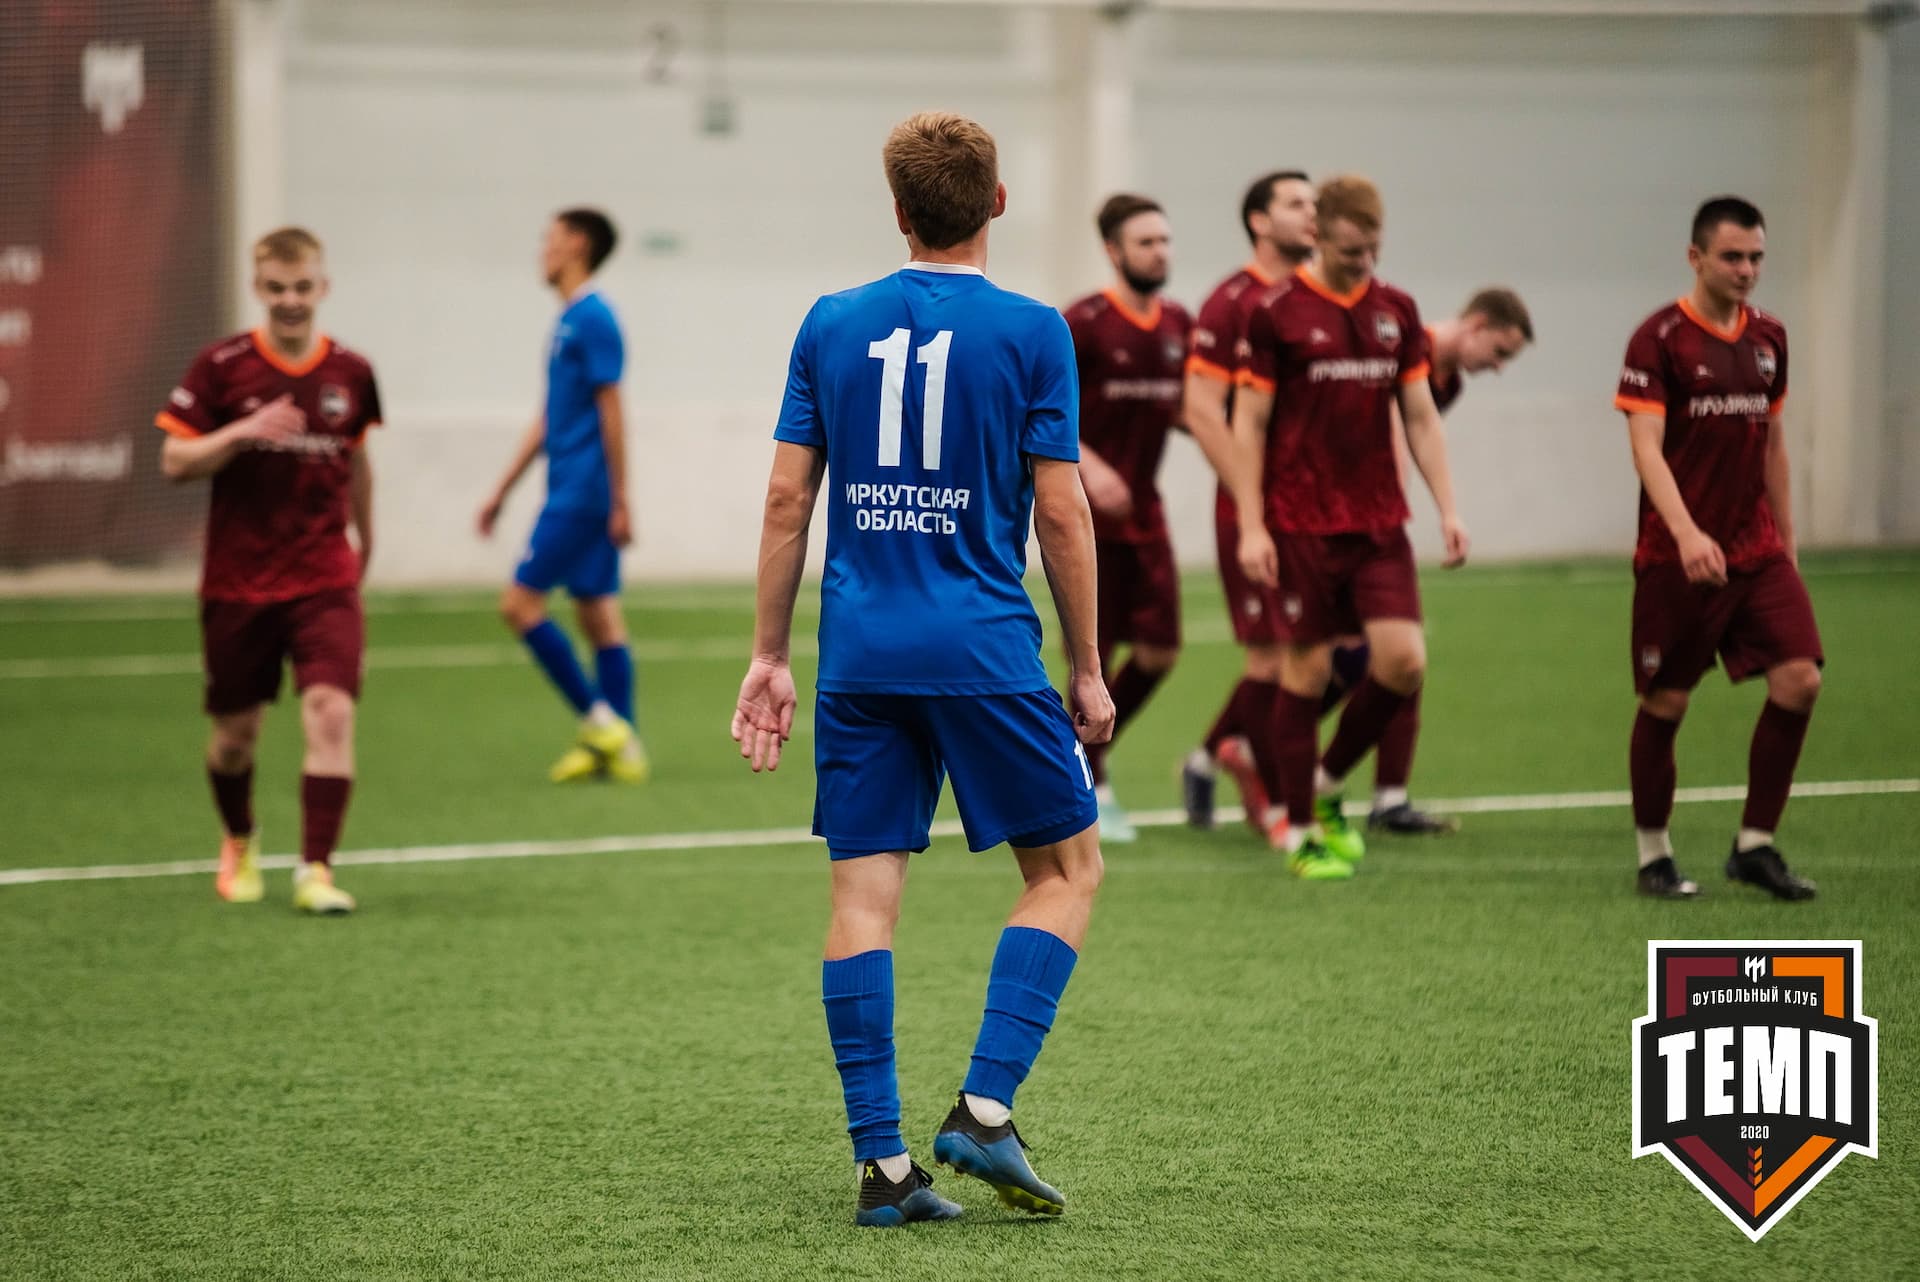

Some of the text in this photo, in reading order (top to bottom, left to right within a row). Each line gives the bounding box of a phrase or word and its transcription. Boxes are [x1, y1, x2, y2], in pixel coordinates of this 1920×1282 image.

[867, 327, 954, 471] 11
[845, 483, 970, 509] ИРКУТСКАЯ
[855, 509, 957, 535] ОБЛАСТЬ
